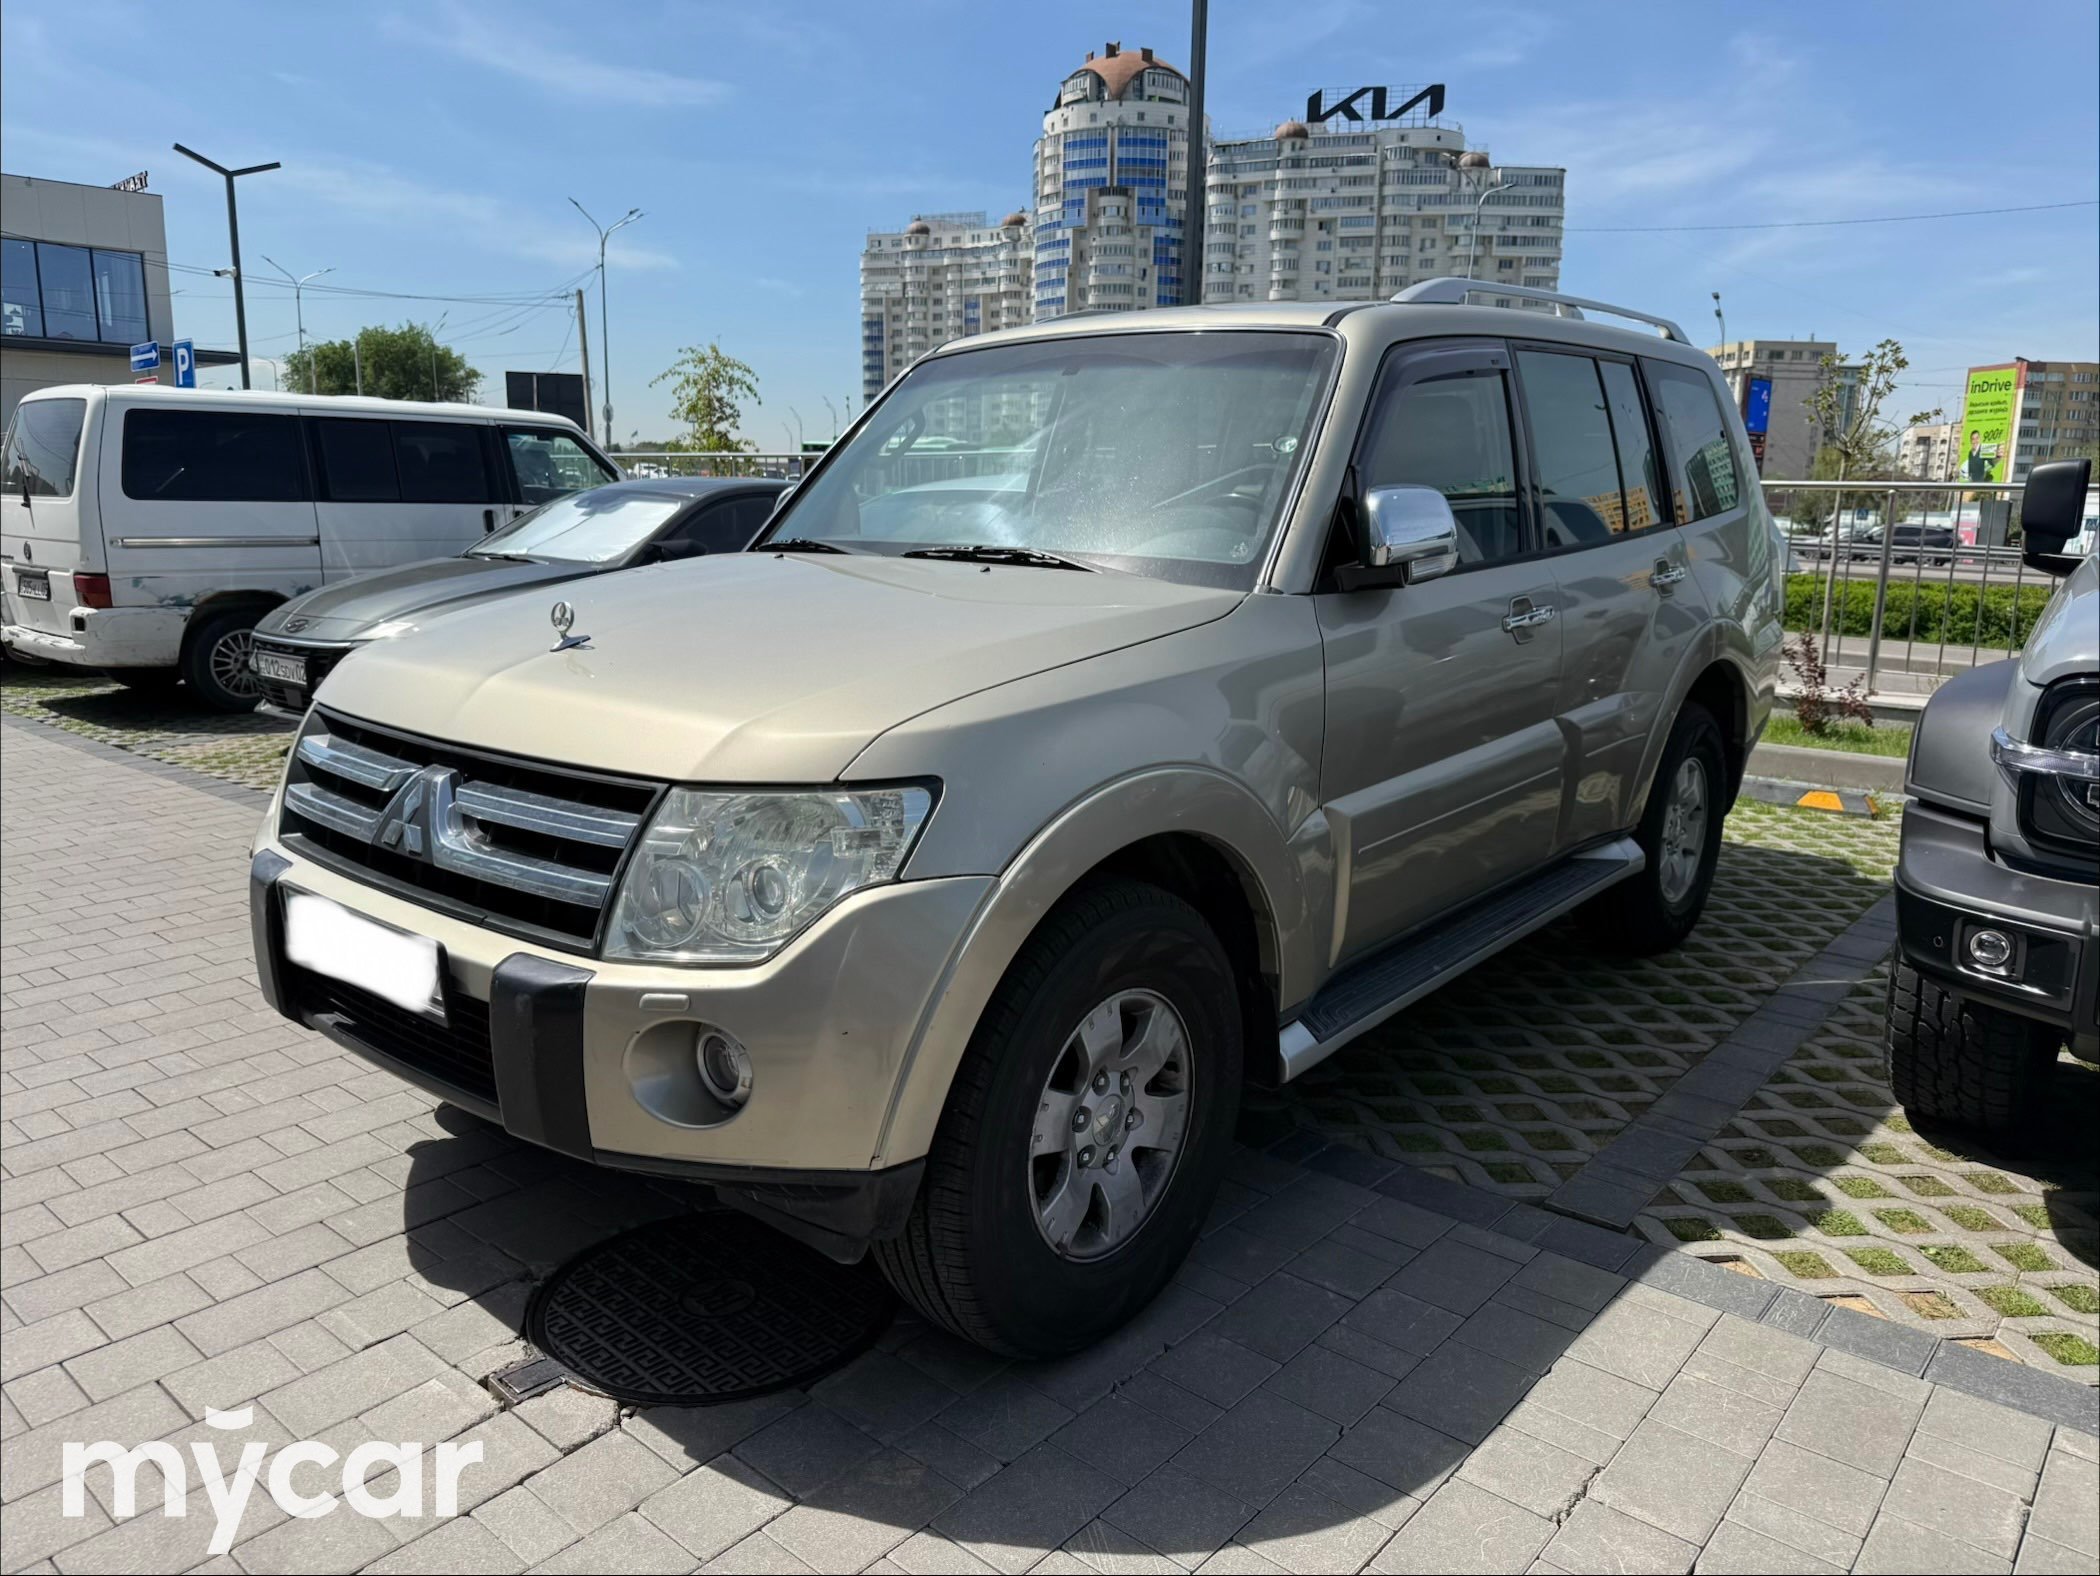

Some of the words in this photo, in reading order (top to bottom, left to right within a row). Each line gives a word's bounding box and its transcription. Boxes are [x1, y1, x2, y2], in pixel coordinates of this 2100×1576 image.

[1307, 84, 1445, 122] KIA
[177, 347, 190, 385] P
[1970, 378, 2012, 394] inDrive
